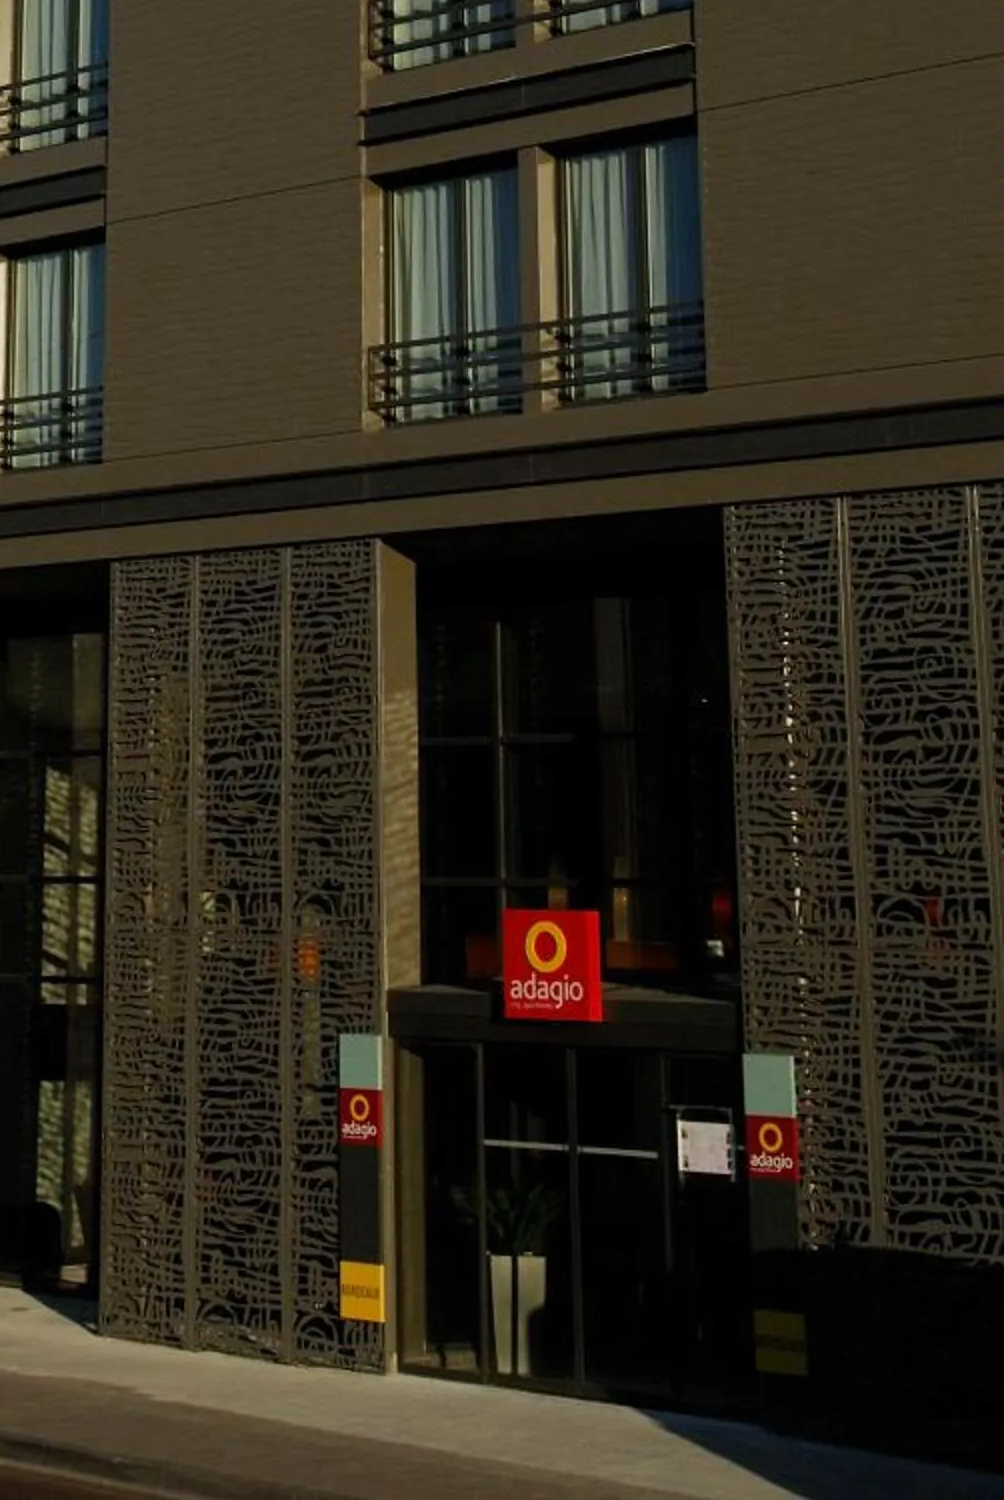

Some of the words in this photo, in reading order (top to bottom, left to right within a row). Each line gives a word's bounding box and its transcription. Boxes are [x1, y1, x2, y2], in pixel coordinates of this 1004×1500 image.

[510, 971, 583, 1009] adagio
[341, 1120, 377, 1139] adagio
[749, 1151, 793, 1172] adagio
